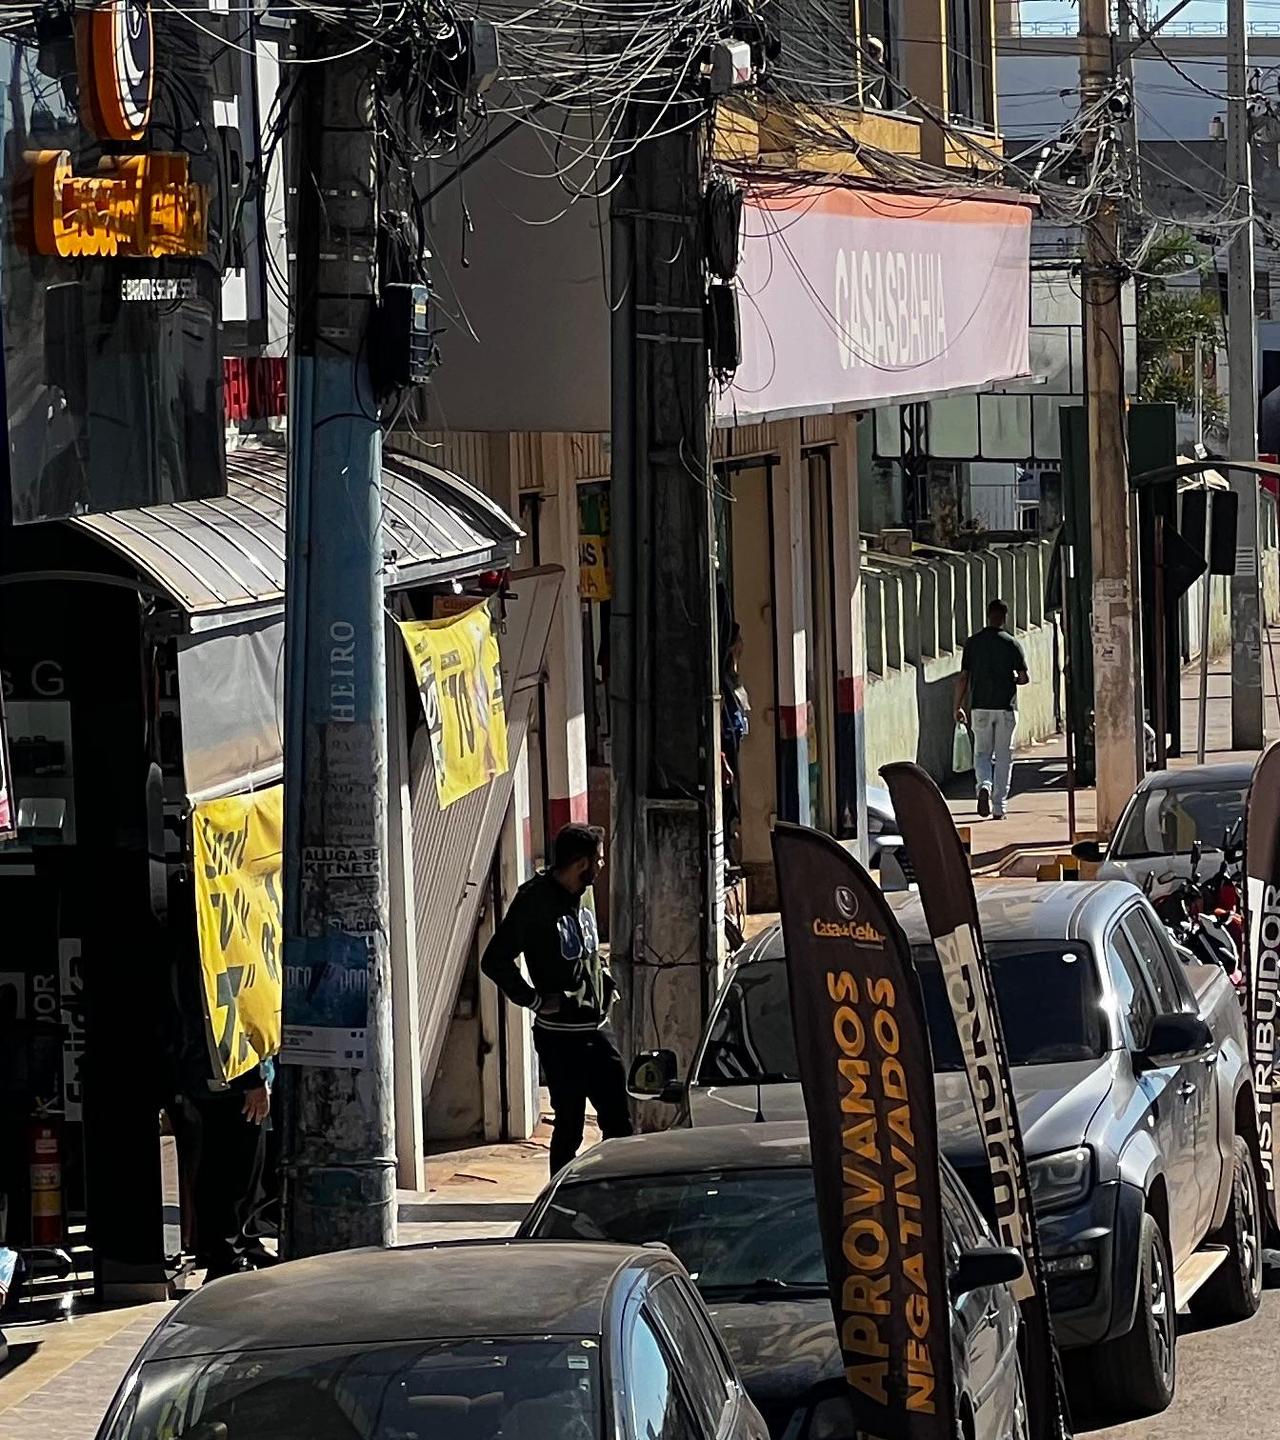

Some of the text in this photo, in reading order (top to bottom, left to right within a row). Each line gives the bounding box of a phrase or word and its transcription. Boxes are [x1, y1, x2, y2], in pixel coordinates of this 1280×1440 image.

[330, 620, 356, 722] HEIRO
[304, 849, 379, 861] ALUGA-SE
[827, 970, 893, 1406] APROVAMOS
[864, 976, 935, 1415] NEGATIVADOS
